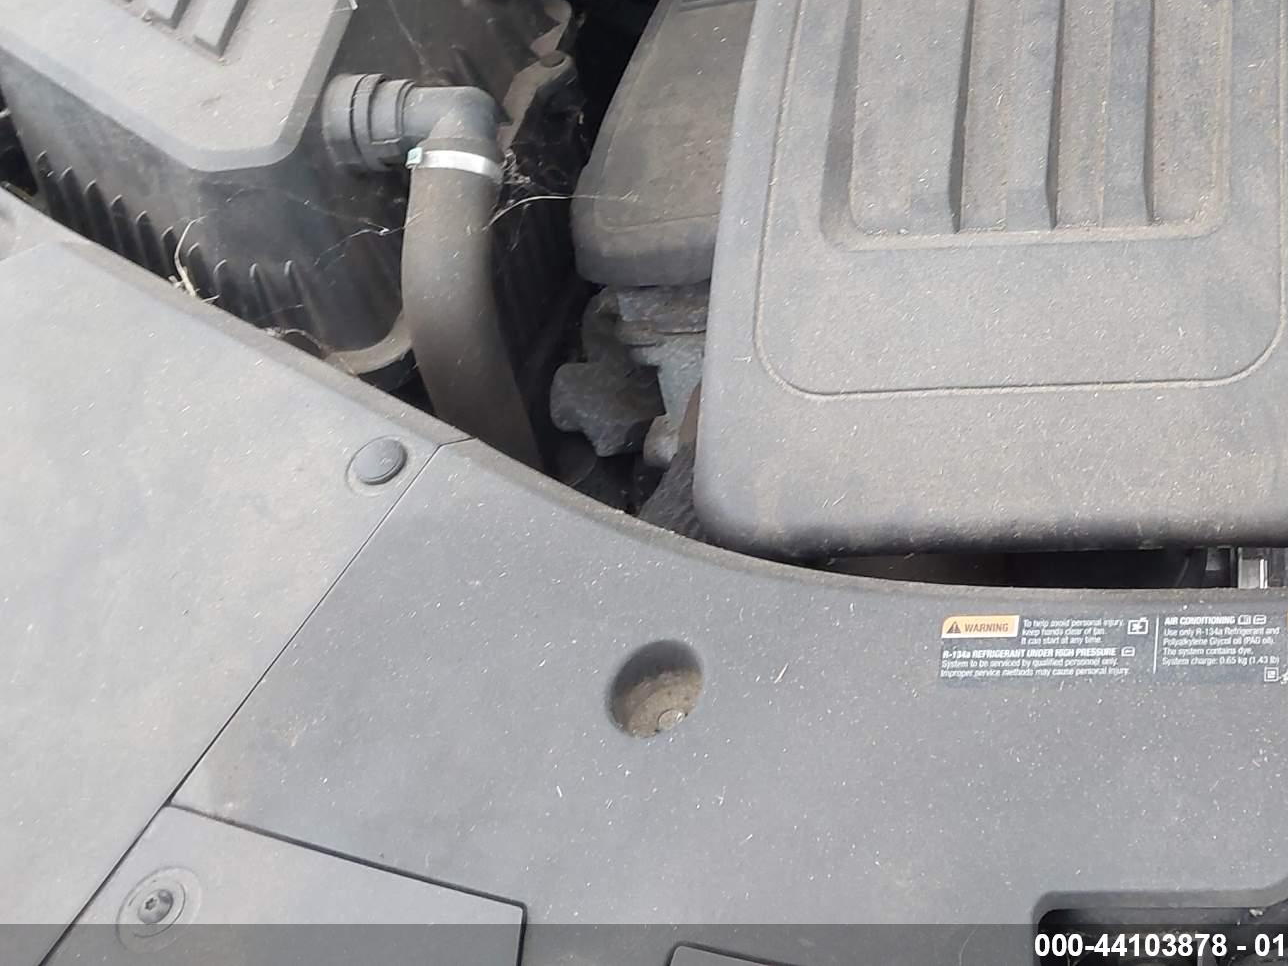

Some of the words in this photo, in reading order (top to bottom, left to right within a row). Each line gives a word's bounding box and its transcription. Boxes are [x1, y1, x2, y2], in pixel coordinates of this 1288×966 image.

[1164, 617, 1178, 625] AIR
[1179, 616, 1235, 625] CONDITIONING
[964, 623, 1009, 633] WARNING
[1265, 627, 1280, 635] and
[972, 649, 1025, 659] REFRIGERANT
[1027, 648, 1054, 658] UNDER
[1055, 648, 1074, 657] HIGH
[1075, 648, 1118, 657] PRESSURE
[1205, 647, 1236, 655] contains
[942, 659, 968, 669] System
[1162, 657, 1189, 666] System
